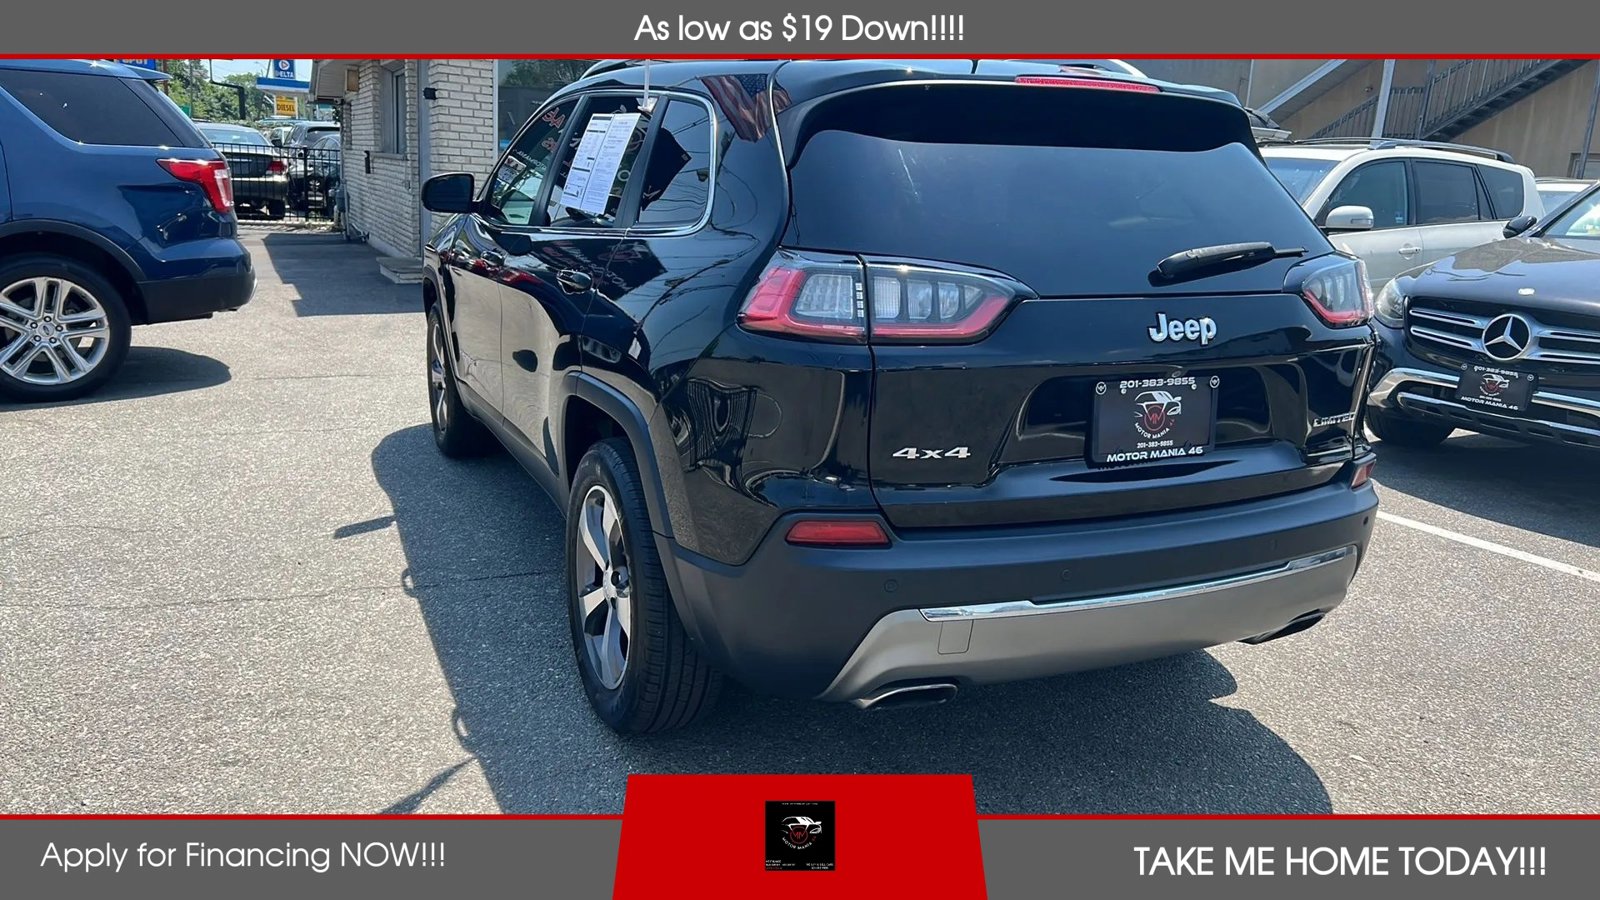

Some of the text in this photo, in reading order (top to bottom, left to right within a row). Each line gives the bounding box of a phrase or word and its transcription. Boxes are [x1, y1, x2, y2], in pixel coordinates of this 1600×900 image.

[276, 103, 295, 112] DIESEL
[1149, 313, 1217, 345] Jeep
[1120, 377, 1196, 389] 201-383-9855
[1461, 396, 1484, 404] MOTOR
[1485, 400, 1507, 408] MANIA
[1134, 422, 1152, 439] MOTOR
[1152, 427, 1170, 439] MANIA
[892, 447, 971, 459] 4x4
[1106, 446, 1204, 463] MOTOR MANIA 46
